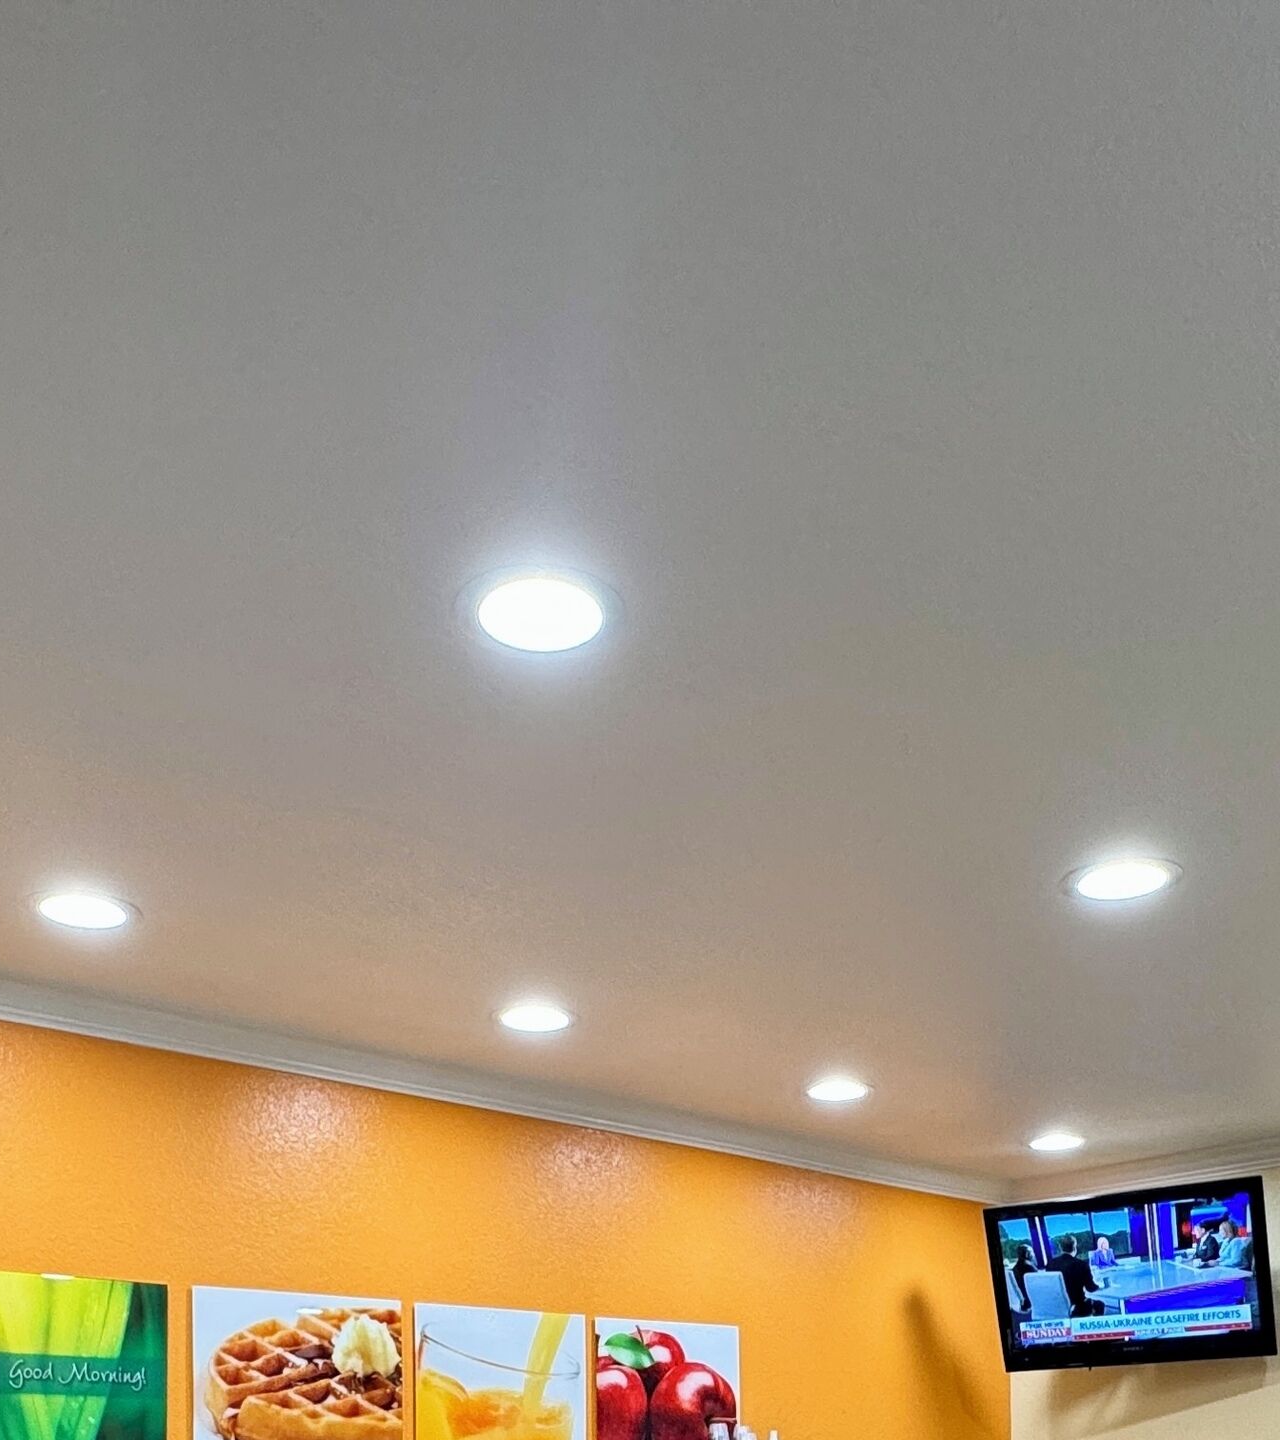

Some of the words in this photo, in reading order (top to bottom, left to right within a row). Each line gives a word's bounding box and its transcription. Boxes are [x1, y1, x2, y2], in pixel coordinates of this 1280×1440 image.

[1079, 1316, 1153, 1330] RUSSIA-UKRAINE
[1154, 1312, 1200, 1325] CEASEFIRE
[1202, 1309, 1242, 1321] EFFORTS
[1026, 1328, 1067, 1339] SUNDAY
[9, 1359, 54, 1389] Good
[58, 1362, 147, 1392] Morning!
